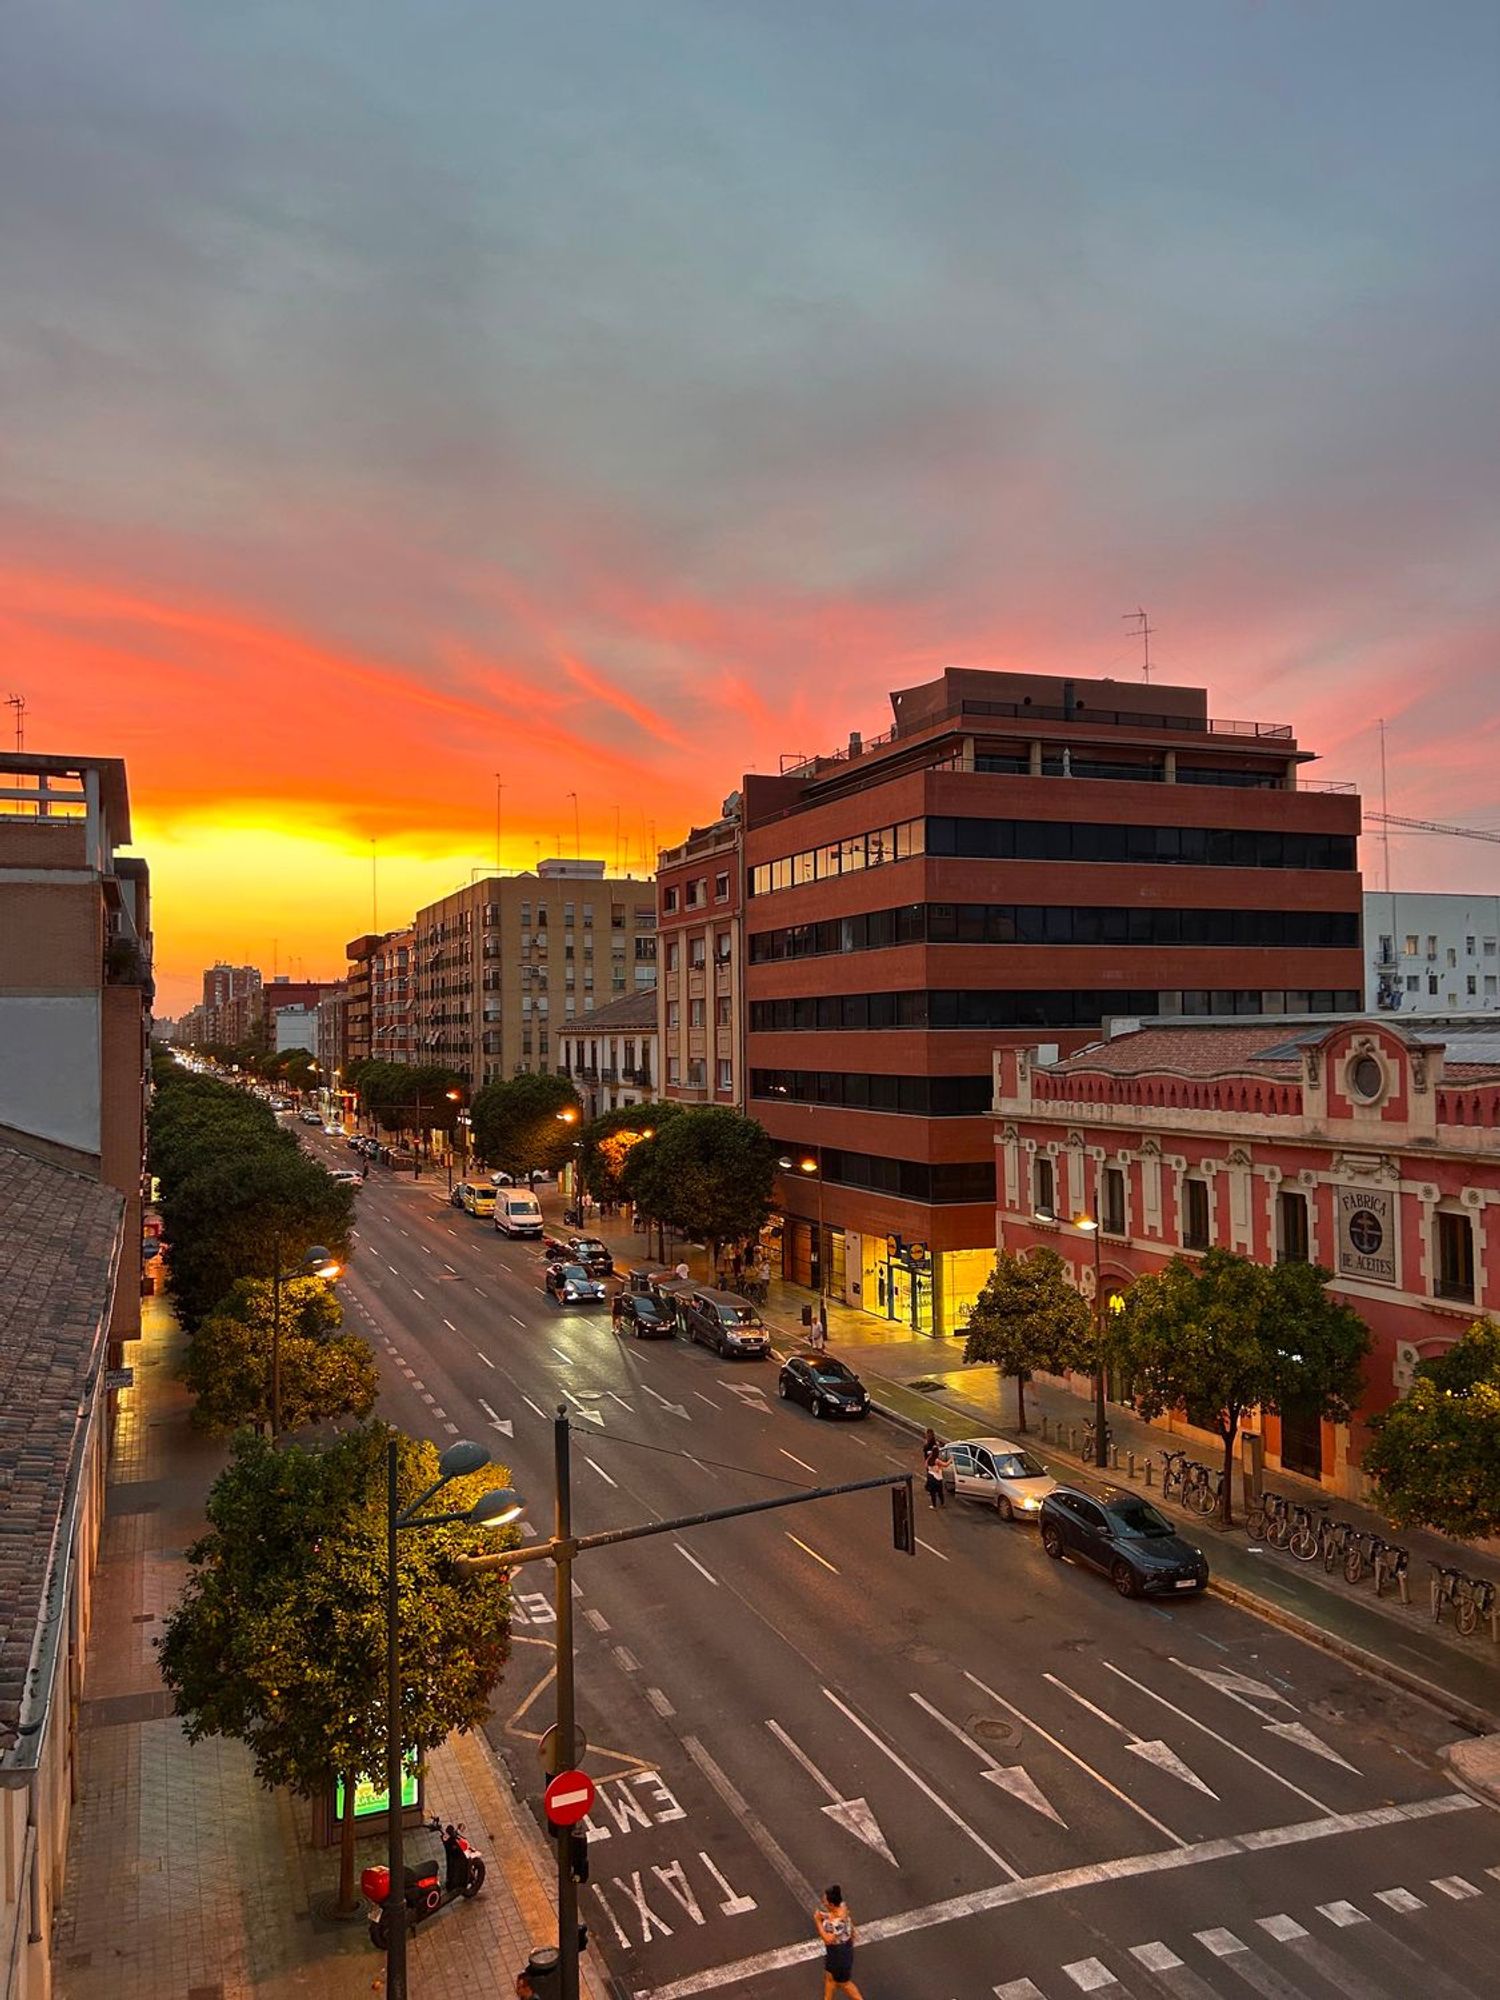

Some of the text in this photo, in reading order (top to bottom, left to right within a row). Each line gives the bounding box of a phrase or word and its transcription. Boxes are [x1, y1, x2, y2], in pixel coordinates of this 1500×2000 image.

[1342, 1253, 1392, 1275] DE ACEITES
[583, 1771, 687, 1844] EMT
[592, 1852, 758, 1949] TAXI
